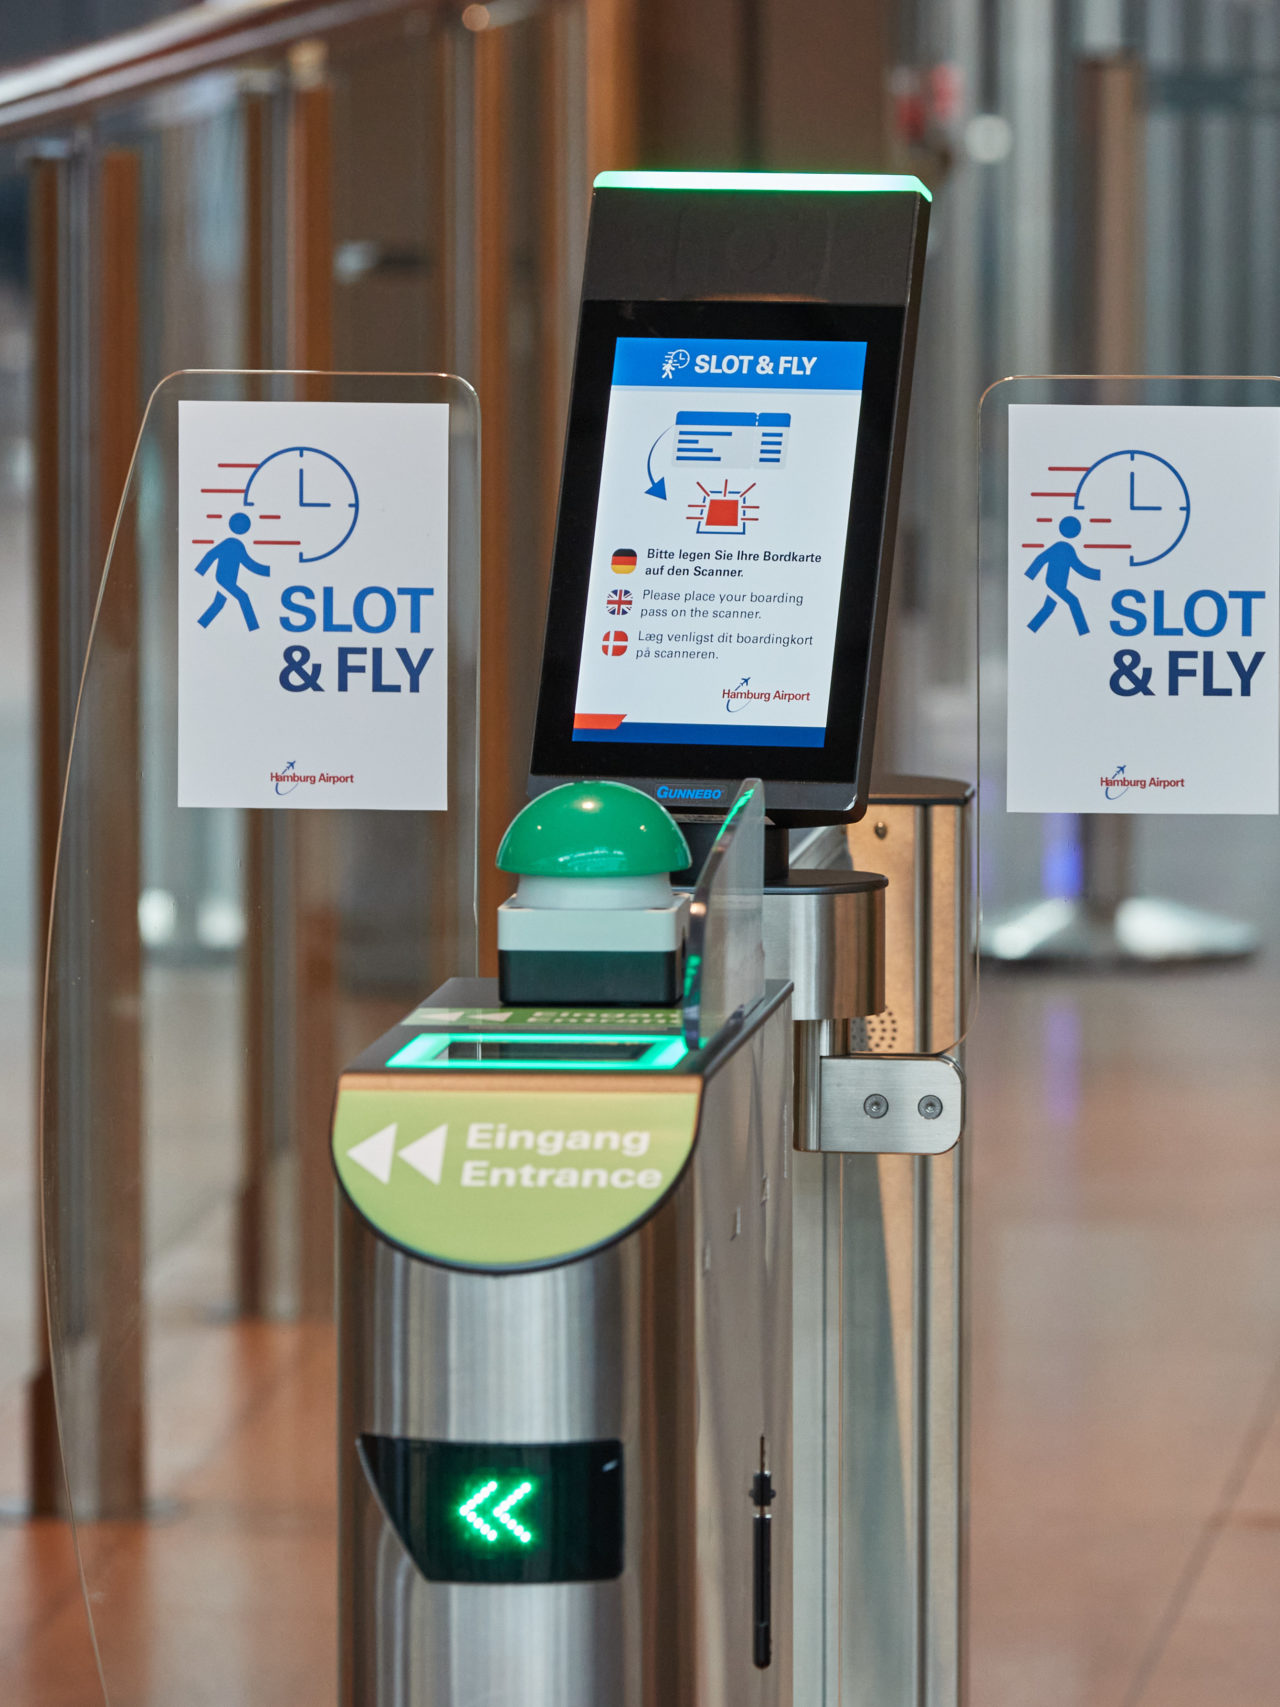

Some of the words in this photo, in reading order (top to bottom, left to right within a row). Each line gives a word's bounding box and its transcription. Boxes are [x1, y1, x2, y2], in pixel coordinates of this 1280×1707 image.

[694, 354, 753, 374] SLOT
[756, 356, 774, 375] &
[778, 356, 817, 375] FLY
[647, 549, 675, 560] Bitte
[678, 549, 710, 564] legen
[714, 550, 733, 562] Sie
[737, 550, 759, 562] Ihre
[763, 551, 822, 563] Bordkarte
[645, 566, 664, 576] auf
[667, 566, 689, 577] den
[693, 567, 744, 578] Scanner.
[642, 590, 681, 601] Please
[684, 591, 715, 605] place
[719, 593, 746, 605] your
[750, 592, 804, 606] boarding
[279, 585, 434, 633] SLOT
[640, 609, 668, 619] pass
[671, 609, 687, 618] on
[690, 608, 709, 619] the
[712, 610, 762, 620] scanner.
[1109, 589, 1266, 638] SLOT
[638, 631, 664, 644] Læg
[667, 632, 714, 645] venligst
[717, 632, 733, 644] dit
[736, 633, 813, 648] boardingkort
[636, 647, 651, 660] på
[654, 650, 719, 660] scanneren.
[279, 645, 325, 693] &
[338, 647, 434, 693] FLY
[1109, 649, 1156, 697] &
[1168, 650, 1266, 697] FLY
[722, 689, 770, 702] Hamburg
[773, 690, 811, 703] Airport
[270, 772, 316, 785] Hamburg
[318, 772, 354, 785] Airport
[1100, 777, 1147, 790] Hamburg
[1149, 777, 1185, 790] Airport
[466, 1123, 651, 1156] Eingang
[460, 1161, 663, 1189] Entrance
